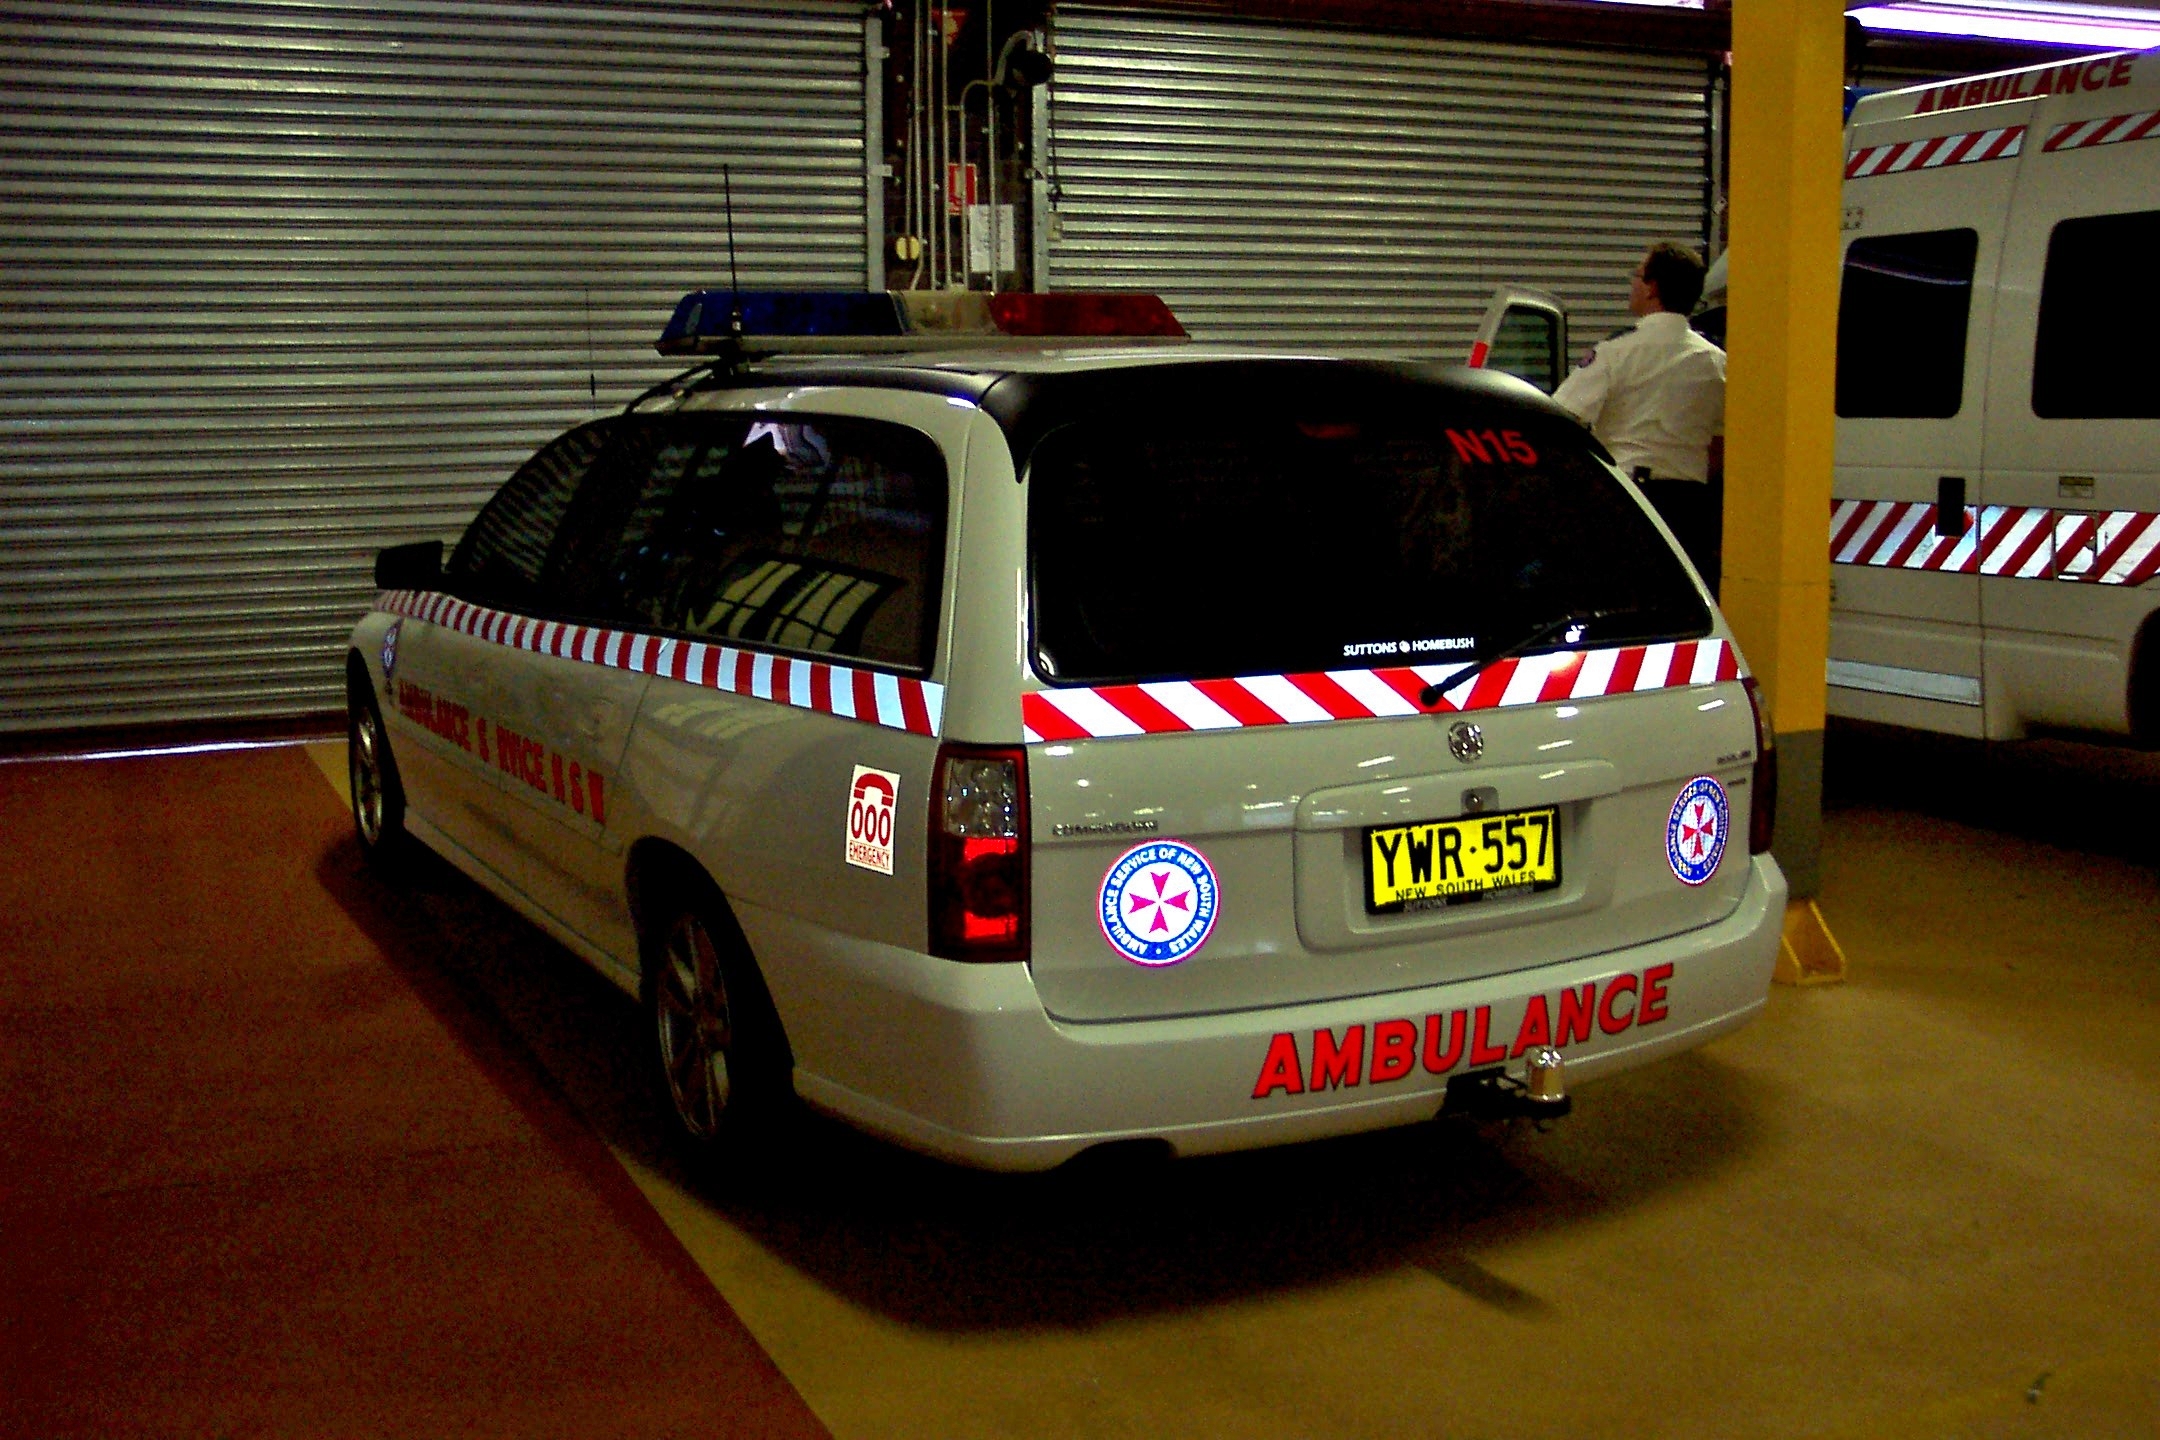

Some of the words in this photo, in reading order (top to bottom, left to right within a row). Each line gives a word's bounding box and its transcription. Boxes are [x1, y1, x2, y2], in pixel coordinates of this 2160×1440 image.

[1914, 53, 2138, 114] AMBULANCE
[1444, 428, 1538, 467] N15
[1343, 642, 1397, 656] SUTTONS
[1412, 637, 1475, 652] HOMEBUSH
[850, 801, 891, 847] 000
[849, 840, 890, 870] EMERGENCY
[1111, 848, 1156, 888] SERVICE
[1159, 847, 1177, 860] OF
[1176, 851, 1203, 875] NEW
[1197, 875, 1212, 918] SOUTH
[1396, 887, 1427, 901] NEW
[1436, 878, 1484, 897] SOUTH
[1492, 870, 1536, 888] WALES
[1105, 889, 1149, 955] AMBULANCE
[1168, 919, 1206, 953] WALES
[1252, 962, 1674, 1099] AMBULANCE
